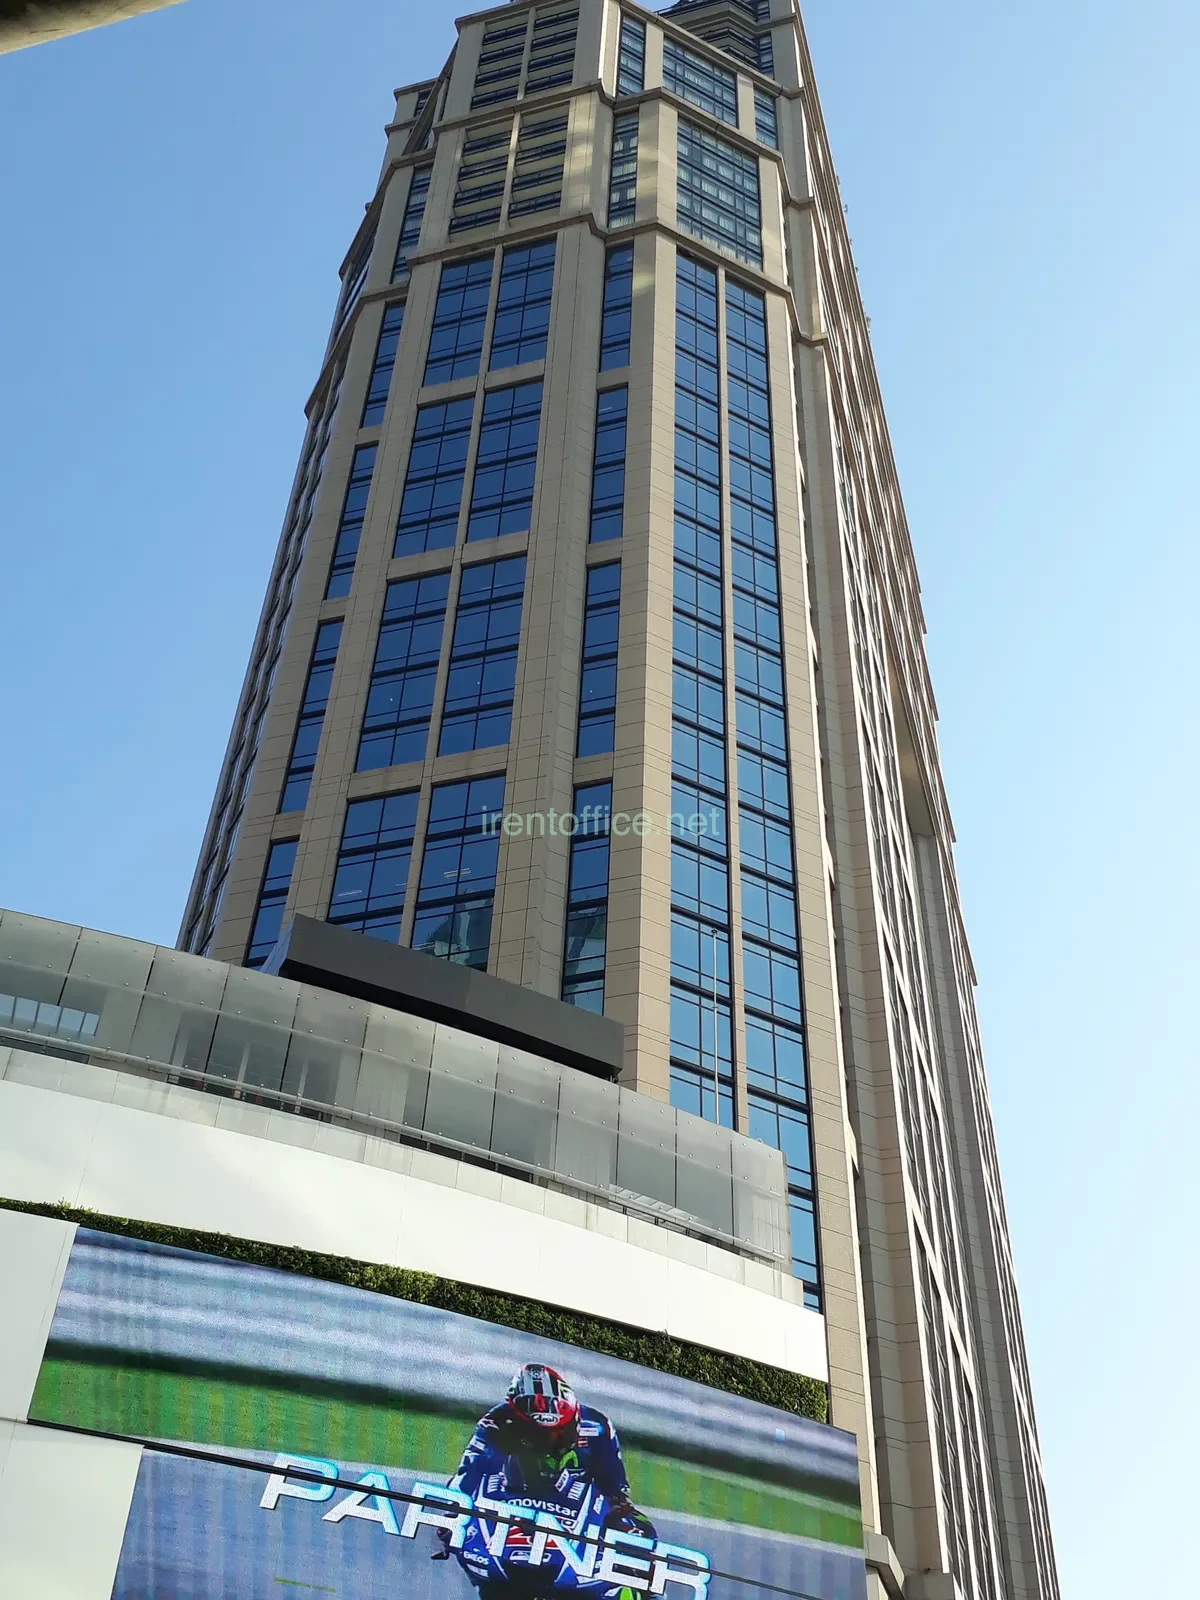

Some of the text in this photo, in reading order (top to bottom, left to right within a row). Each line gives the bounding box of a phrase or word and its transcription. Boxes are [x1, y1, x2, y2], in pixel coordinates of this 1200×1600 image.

[533, 1414, 558, 1425] Arai
[508, 1498, 578, 1517] movistar
[258, 1452, 711, 1600] PARTNER
